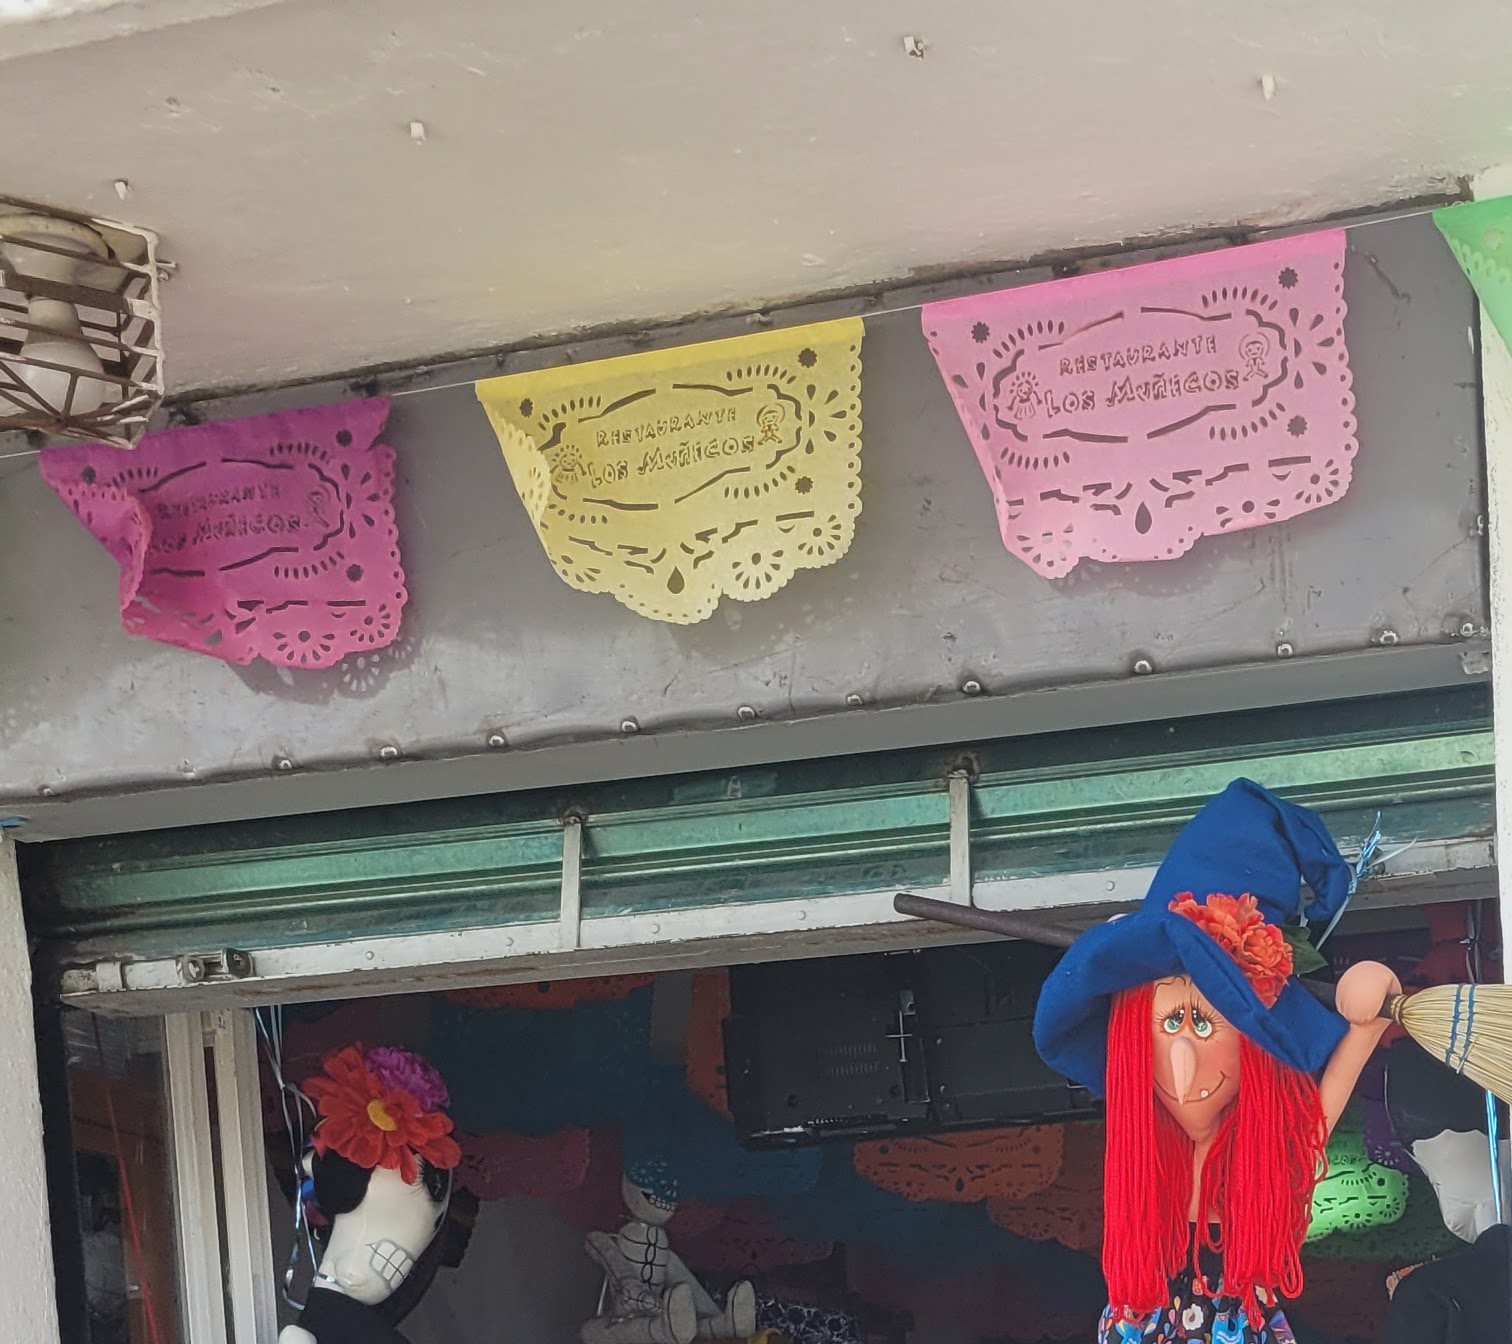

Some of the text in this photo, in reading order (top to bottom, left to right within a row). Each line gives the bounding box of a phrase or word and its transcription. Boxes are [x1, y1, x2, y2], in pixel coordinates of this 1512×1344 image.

[1060, 335, 1217, 376] RESTAURANTE
[1044, 390, 1096, 418] LOS
[596, 407, 736, 447] RESTAURANTE
[587, 460, 628, 488] LOS
